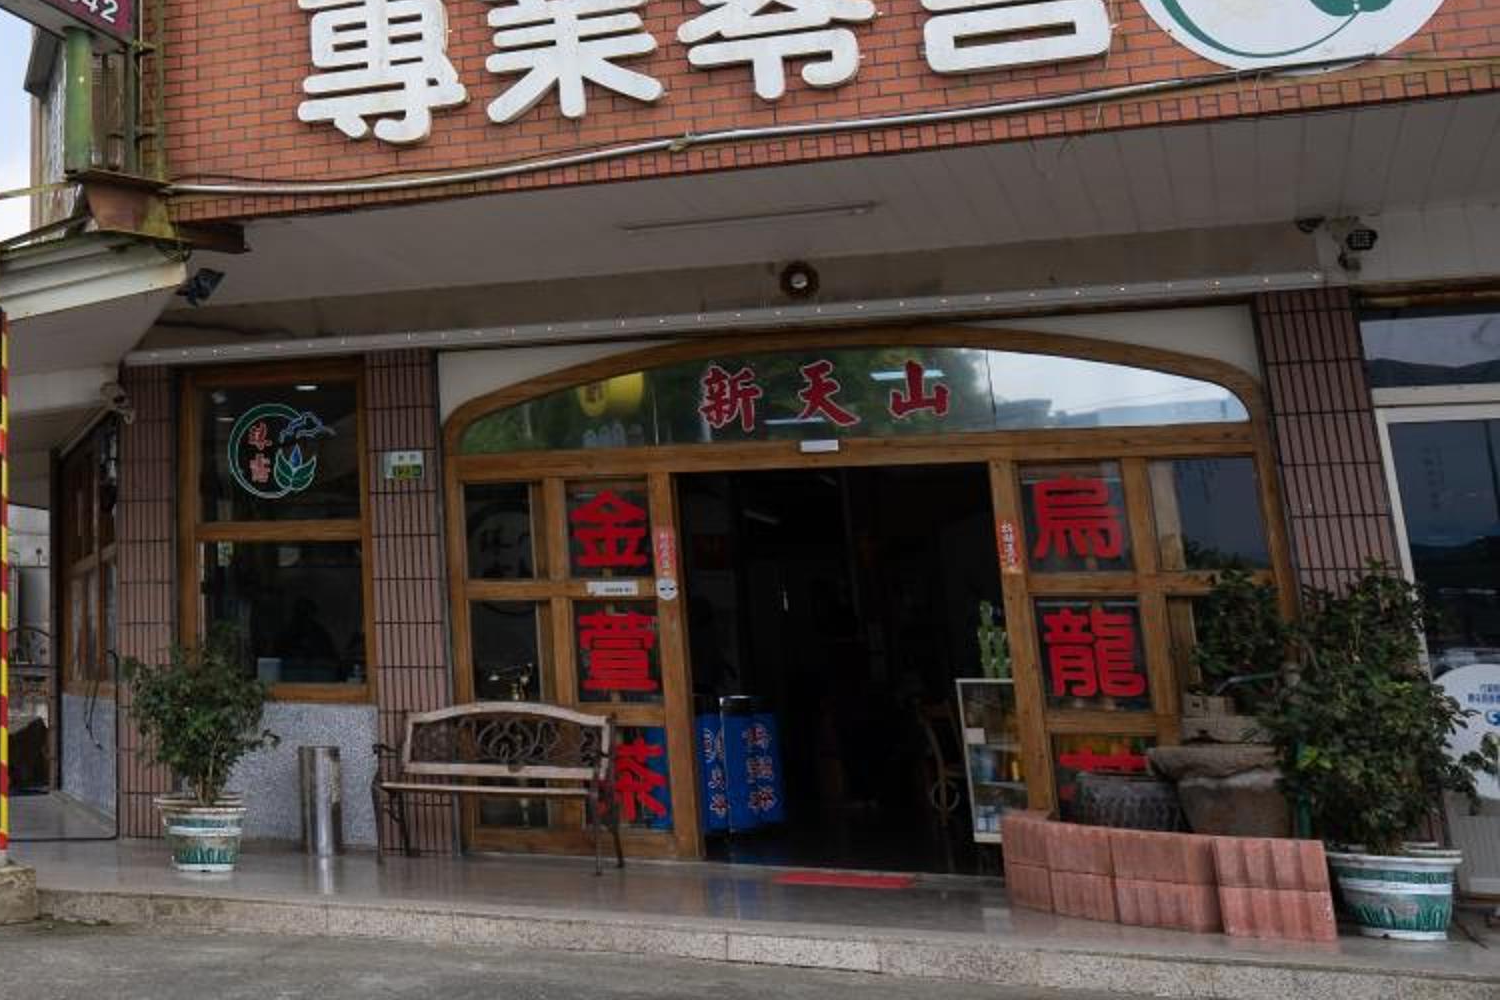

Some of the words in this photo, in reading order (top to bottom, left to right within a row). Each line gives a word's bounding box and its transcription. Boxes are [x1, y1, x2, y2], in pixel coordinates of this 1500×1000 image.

[698, 360, 949, 432] 新天山
[1032, 472, 1150, 775] 烏龍
